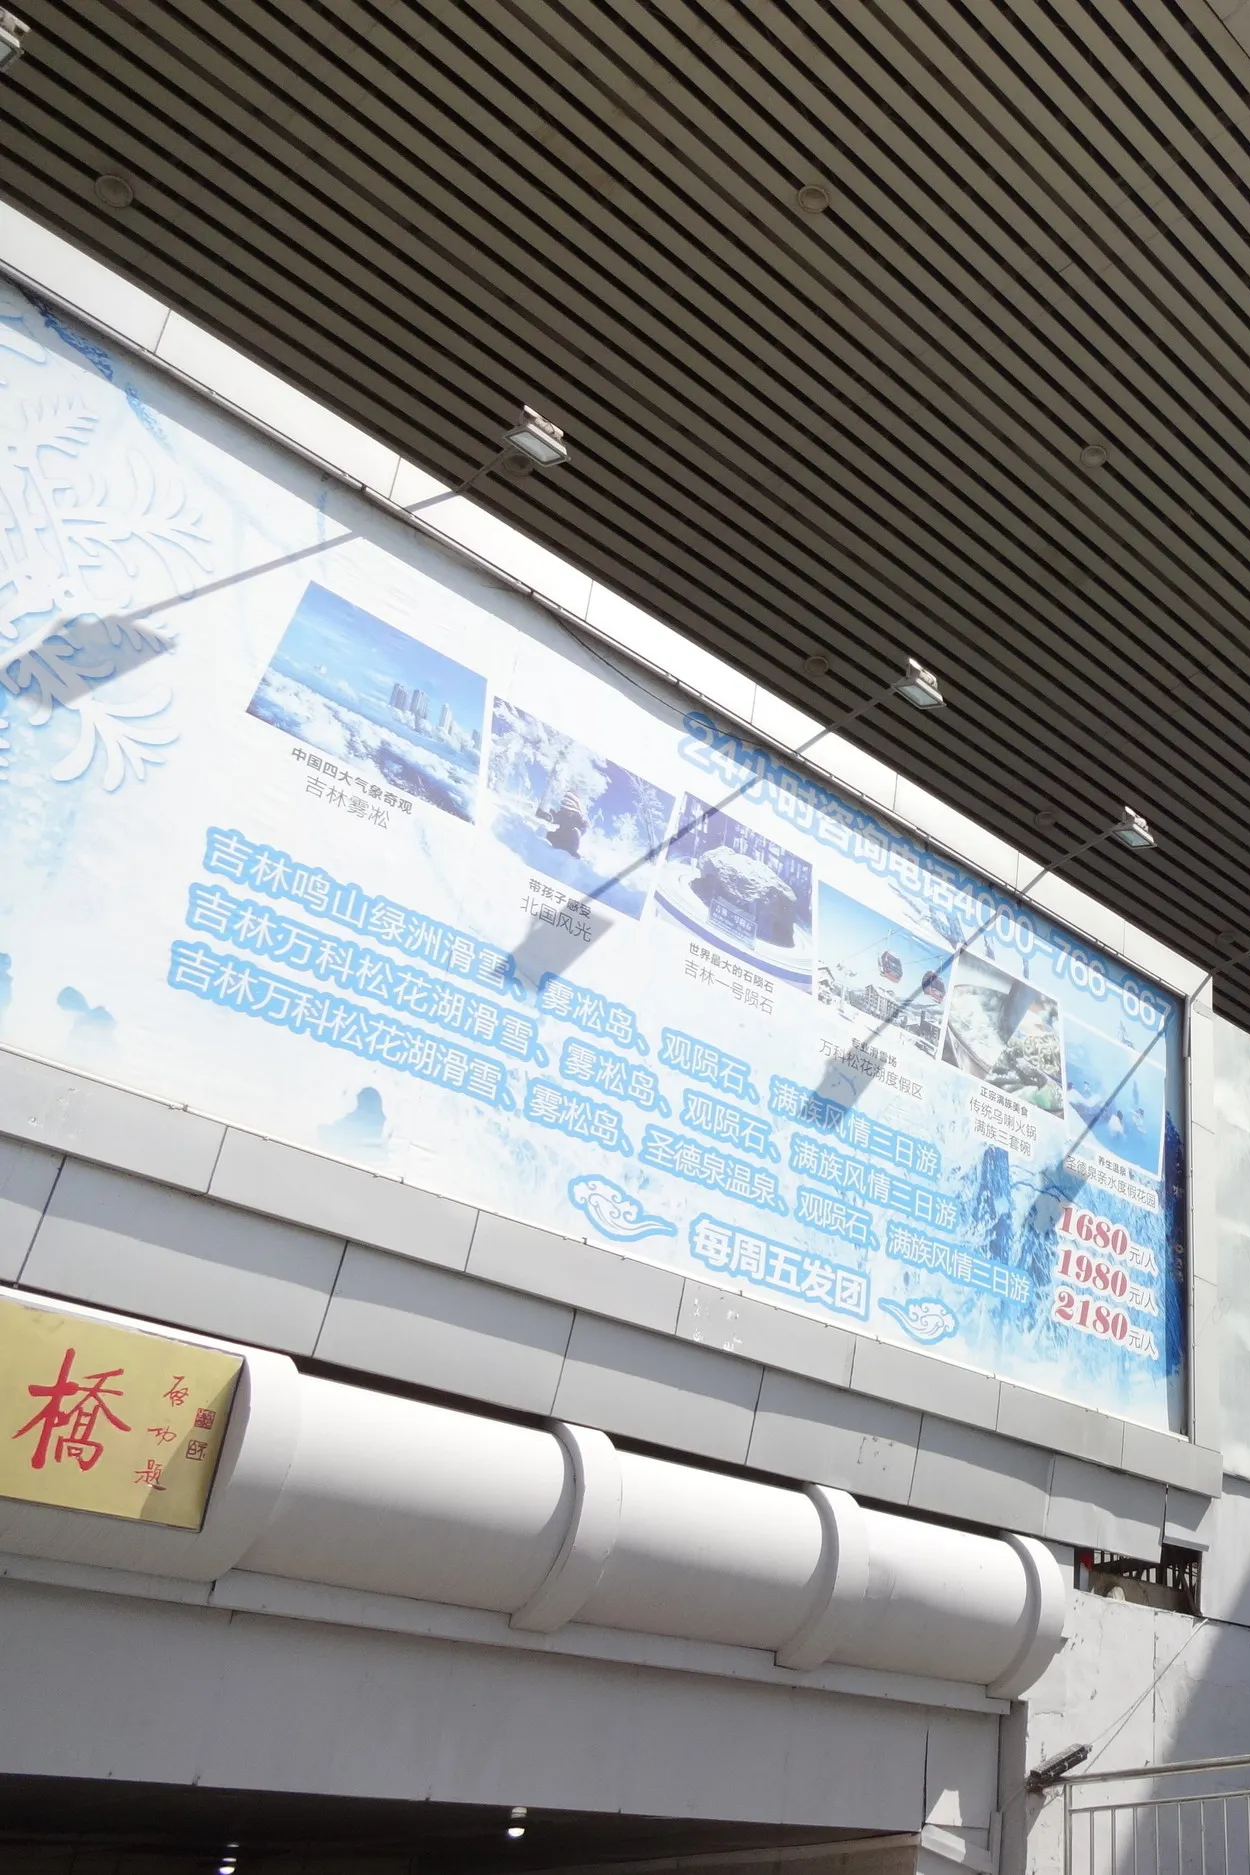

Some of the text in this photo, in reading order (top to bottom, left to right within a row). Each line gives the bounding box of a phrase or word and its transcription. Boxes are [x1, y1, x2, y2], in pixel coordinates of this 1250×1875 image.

[292, 747, 413, 815] 中国四大气象奇观
[305, 775, 391, 830] 吉林雾凇
[520, 895, 592, 942] 北国风光
[528, 878, 592, 919] 带孩子感受
[684, 959, 775, 1015] 吉林一号陨石
[689, 942, 775, 994] 世界最大的石陨石
[819, 1038, 923, 1101] 万科松花湖度假区
[851, 1037, 897, 1068] 专业滑雪场
[980, 1085, 1029, 1117] 正宗满族美食
[974, 1118, 1031, 1156] 满族三套碗
[1066, 1154, 1156, 1209] 圣德泉亲水度假花园
[693, 1218, 868, 1317] 每周五发团
[11, 1347, 132, 1472] 橋
